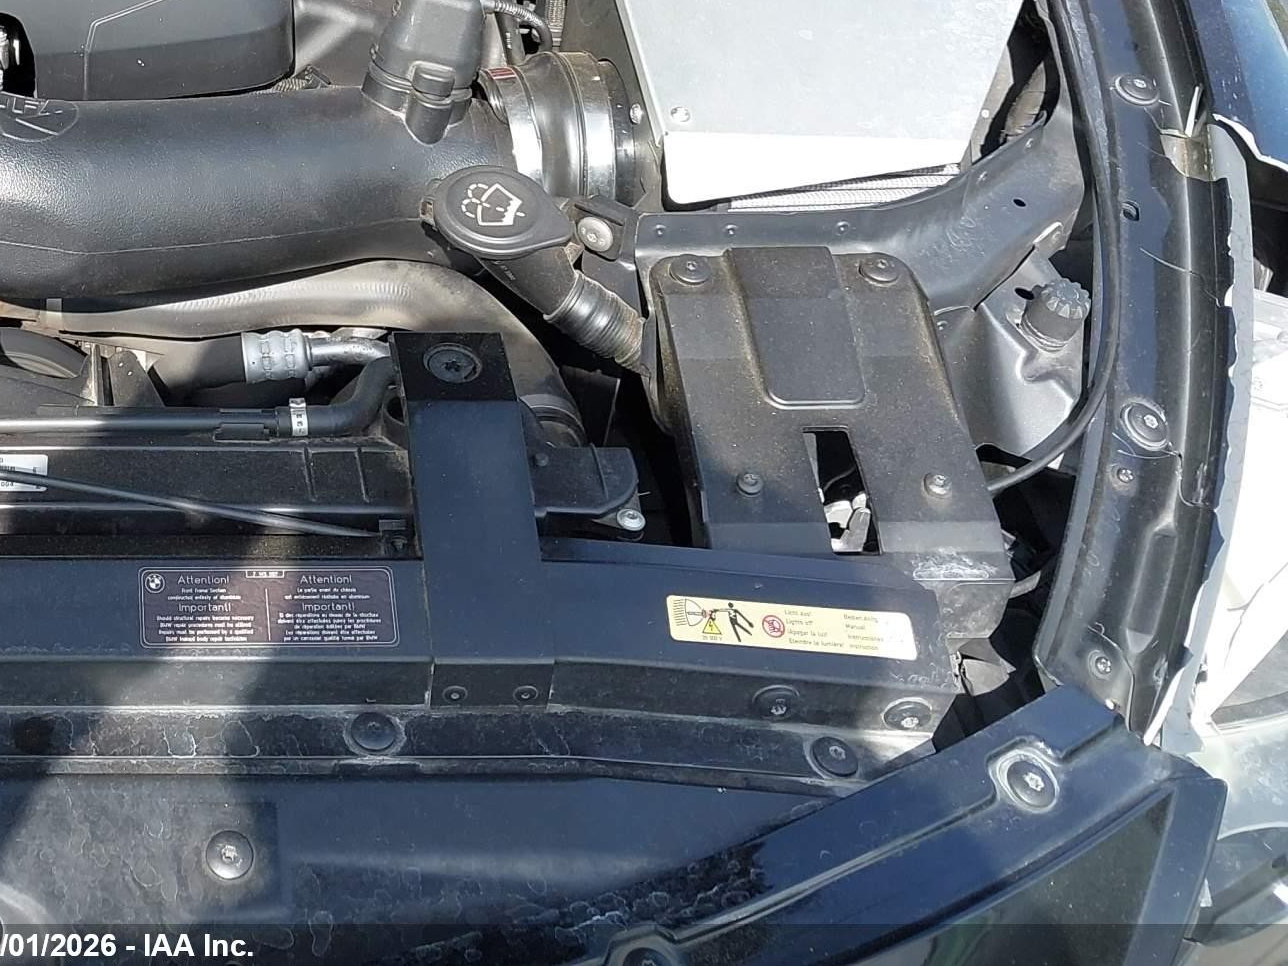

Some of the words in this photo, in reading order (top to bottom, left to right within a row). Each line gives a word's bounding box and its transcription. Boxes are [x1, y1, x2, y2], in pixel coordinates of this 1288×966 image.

[177, 575, 230, 585] Attention!
[300, 575, 353, 584] Attention!
[178, 603, 232, 612] Important!
[302, 602, 355, 611] Important!
